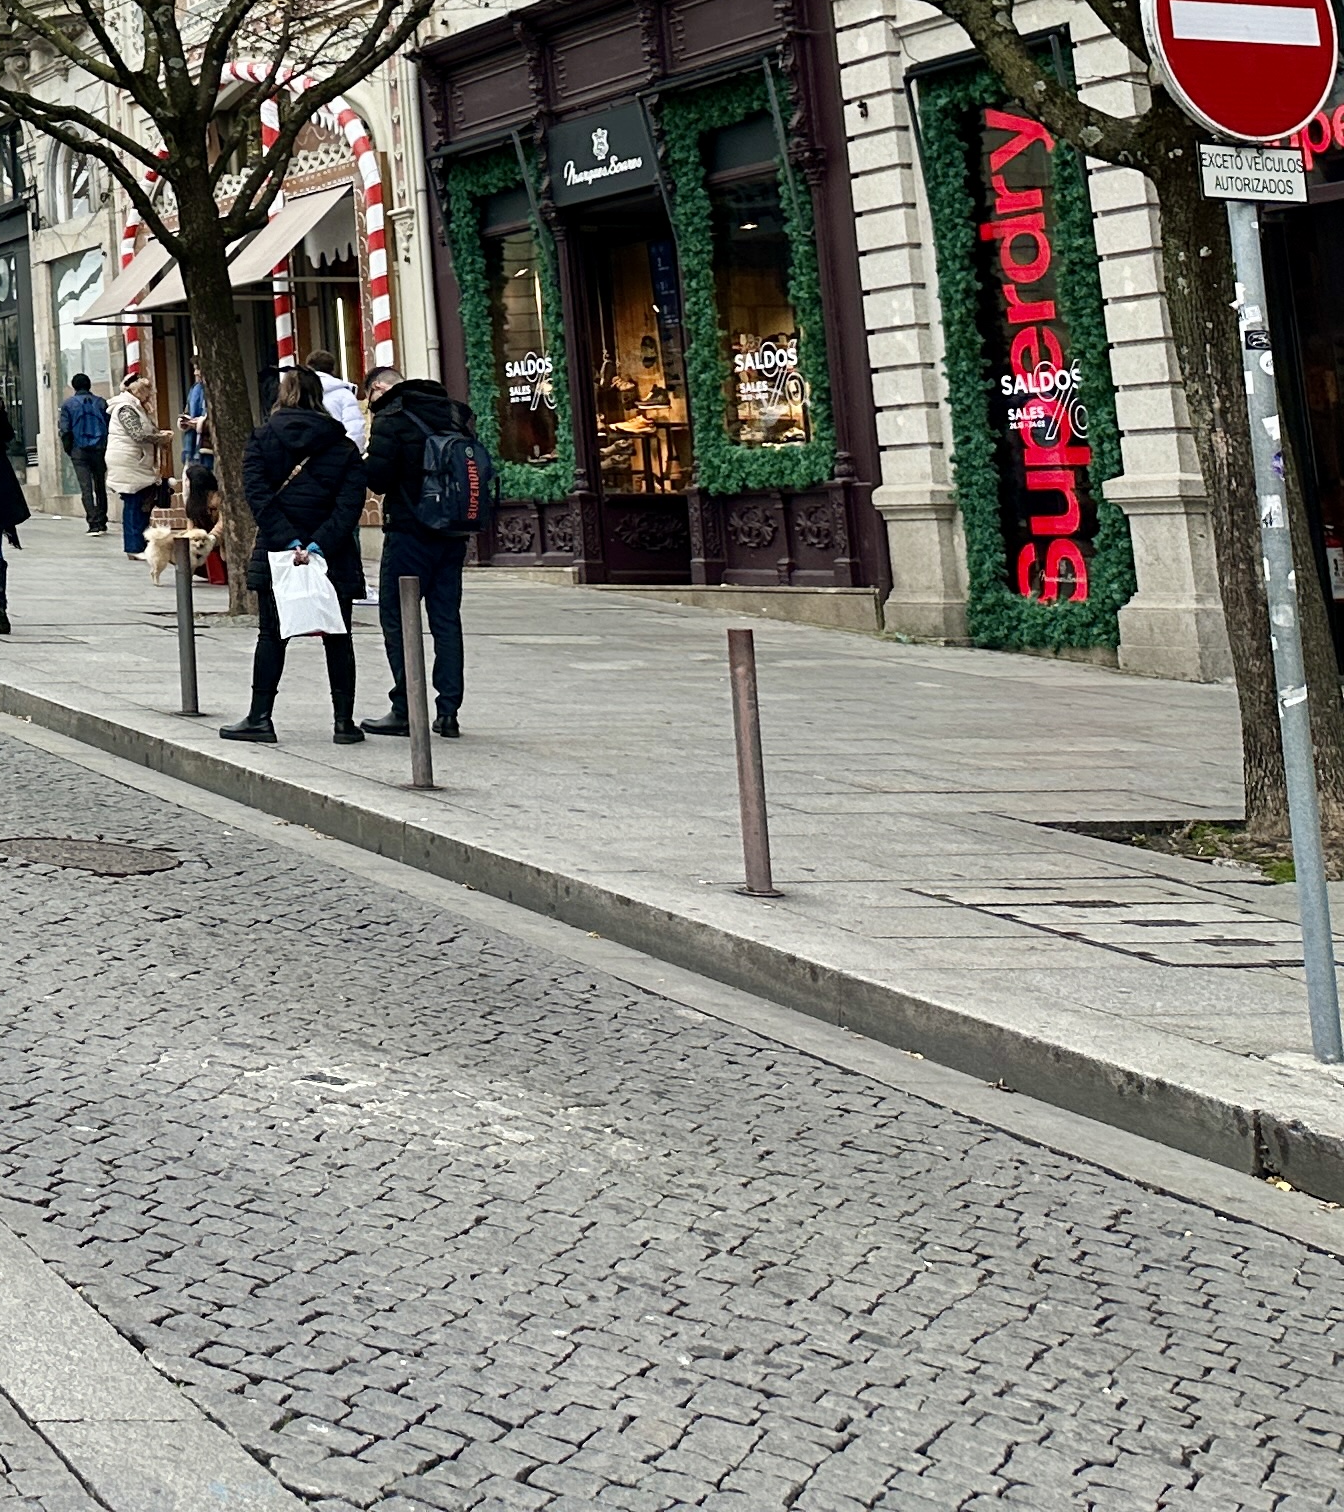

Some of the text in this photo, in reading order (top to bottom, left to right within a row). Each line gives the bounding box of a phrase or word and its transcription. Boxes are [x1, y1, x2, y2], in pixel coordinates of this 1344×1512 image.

[1201, 152, 1243, 170] EXCETO
[1215, 175, 1293, 194] AUTORIZADOS
[505, 357, 553, 378] SALDOS
[734, 347, 798, 373] SALDOS
[509, 385, 531, 396] SALES
[740, 381, 768, 394] SALES
[1001, 368, 1083, 396] SALDOS
[1007, 406, 1045, 420] SALES
